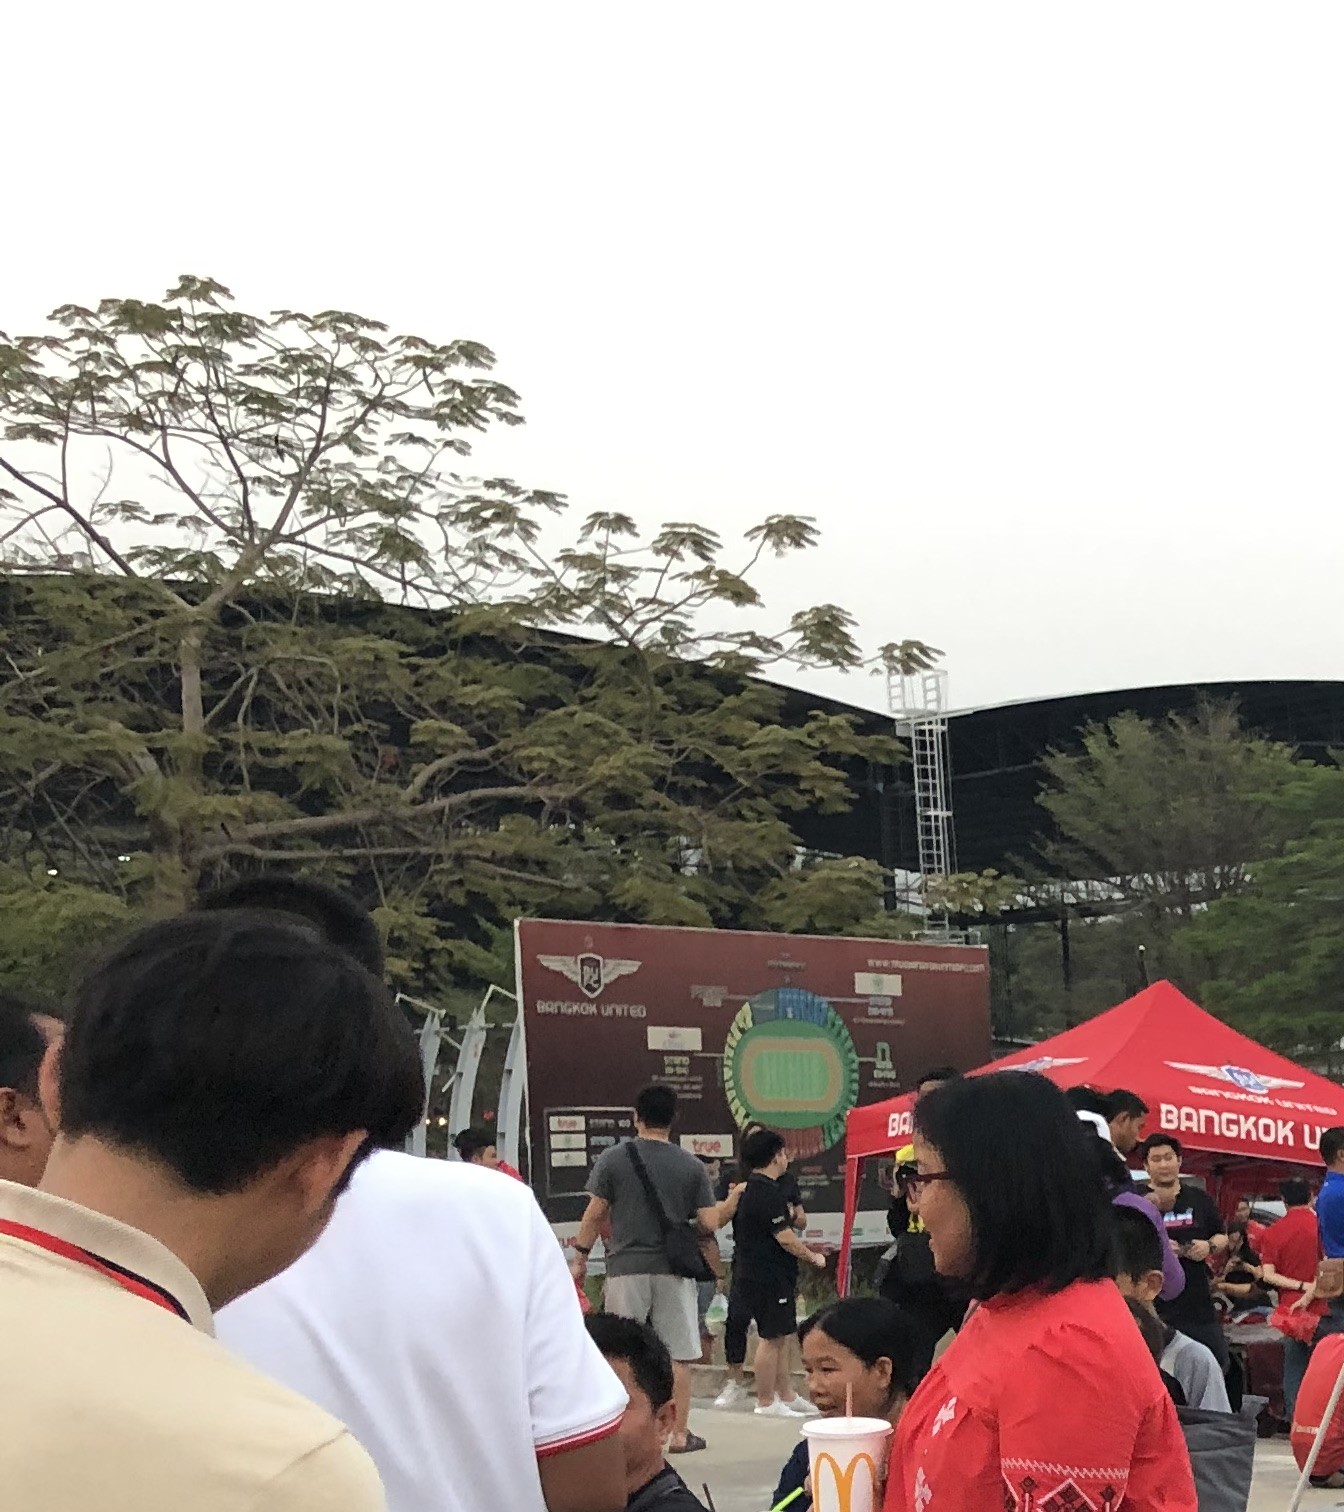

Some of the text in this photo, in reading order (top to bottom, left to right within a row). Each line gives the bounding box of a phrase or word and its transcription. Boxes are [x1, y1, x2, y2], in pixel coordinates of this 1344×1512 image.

[536, 1000, 647, 1018] BANGKOK UNITED
[1160, 1103, 1295, 1147] BANGKOK
[692, 1138, 722, 1153] true
